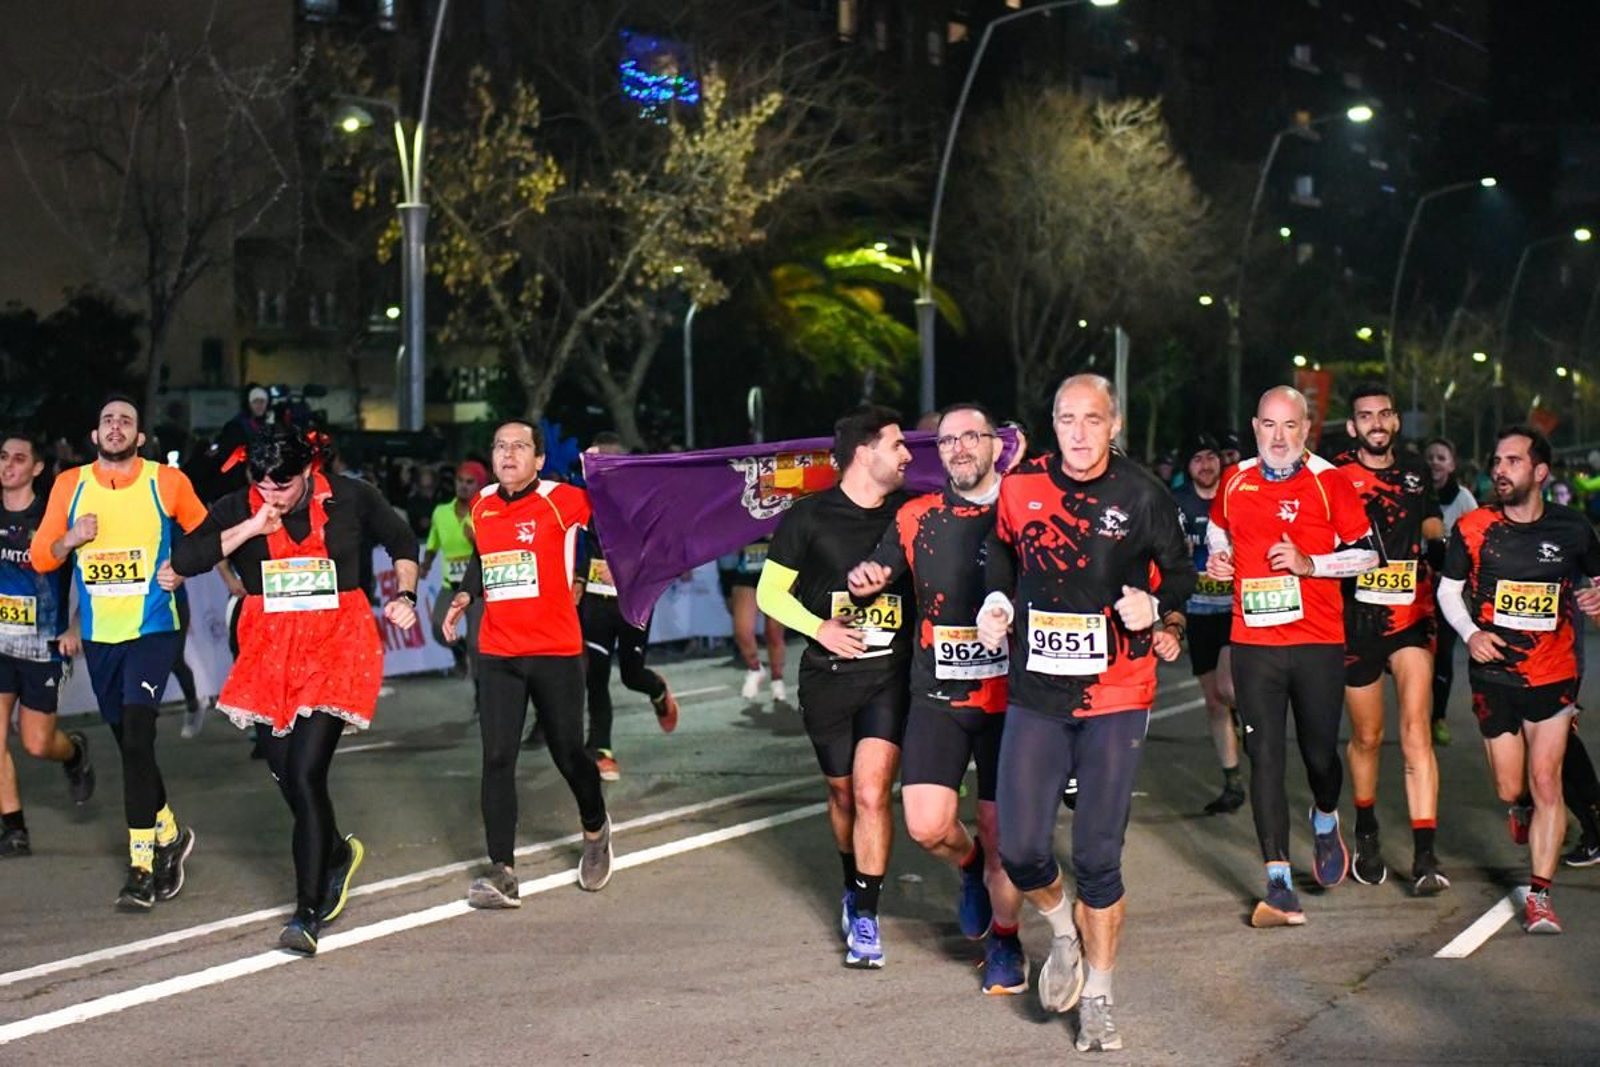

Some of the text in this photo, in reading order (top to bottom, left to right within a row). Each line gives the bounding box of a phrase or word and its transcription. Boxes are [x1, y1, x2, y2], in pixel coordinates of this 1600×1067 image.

[88, 562, 138, 580] 3931
[484, 563, 532, 585] 2742
[1364, 572, 1411, 589] 9636
[268, 571, 332, 594] 1224
[1244, 591, 1295, 610] 1197
[1501, 594, 1554, 613] 9642
[1034, 629, 1095, 652] 9651
